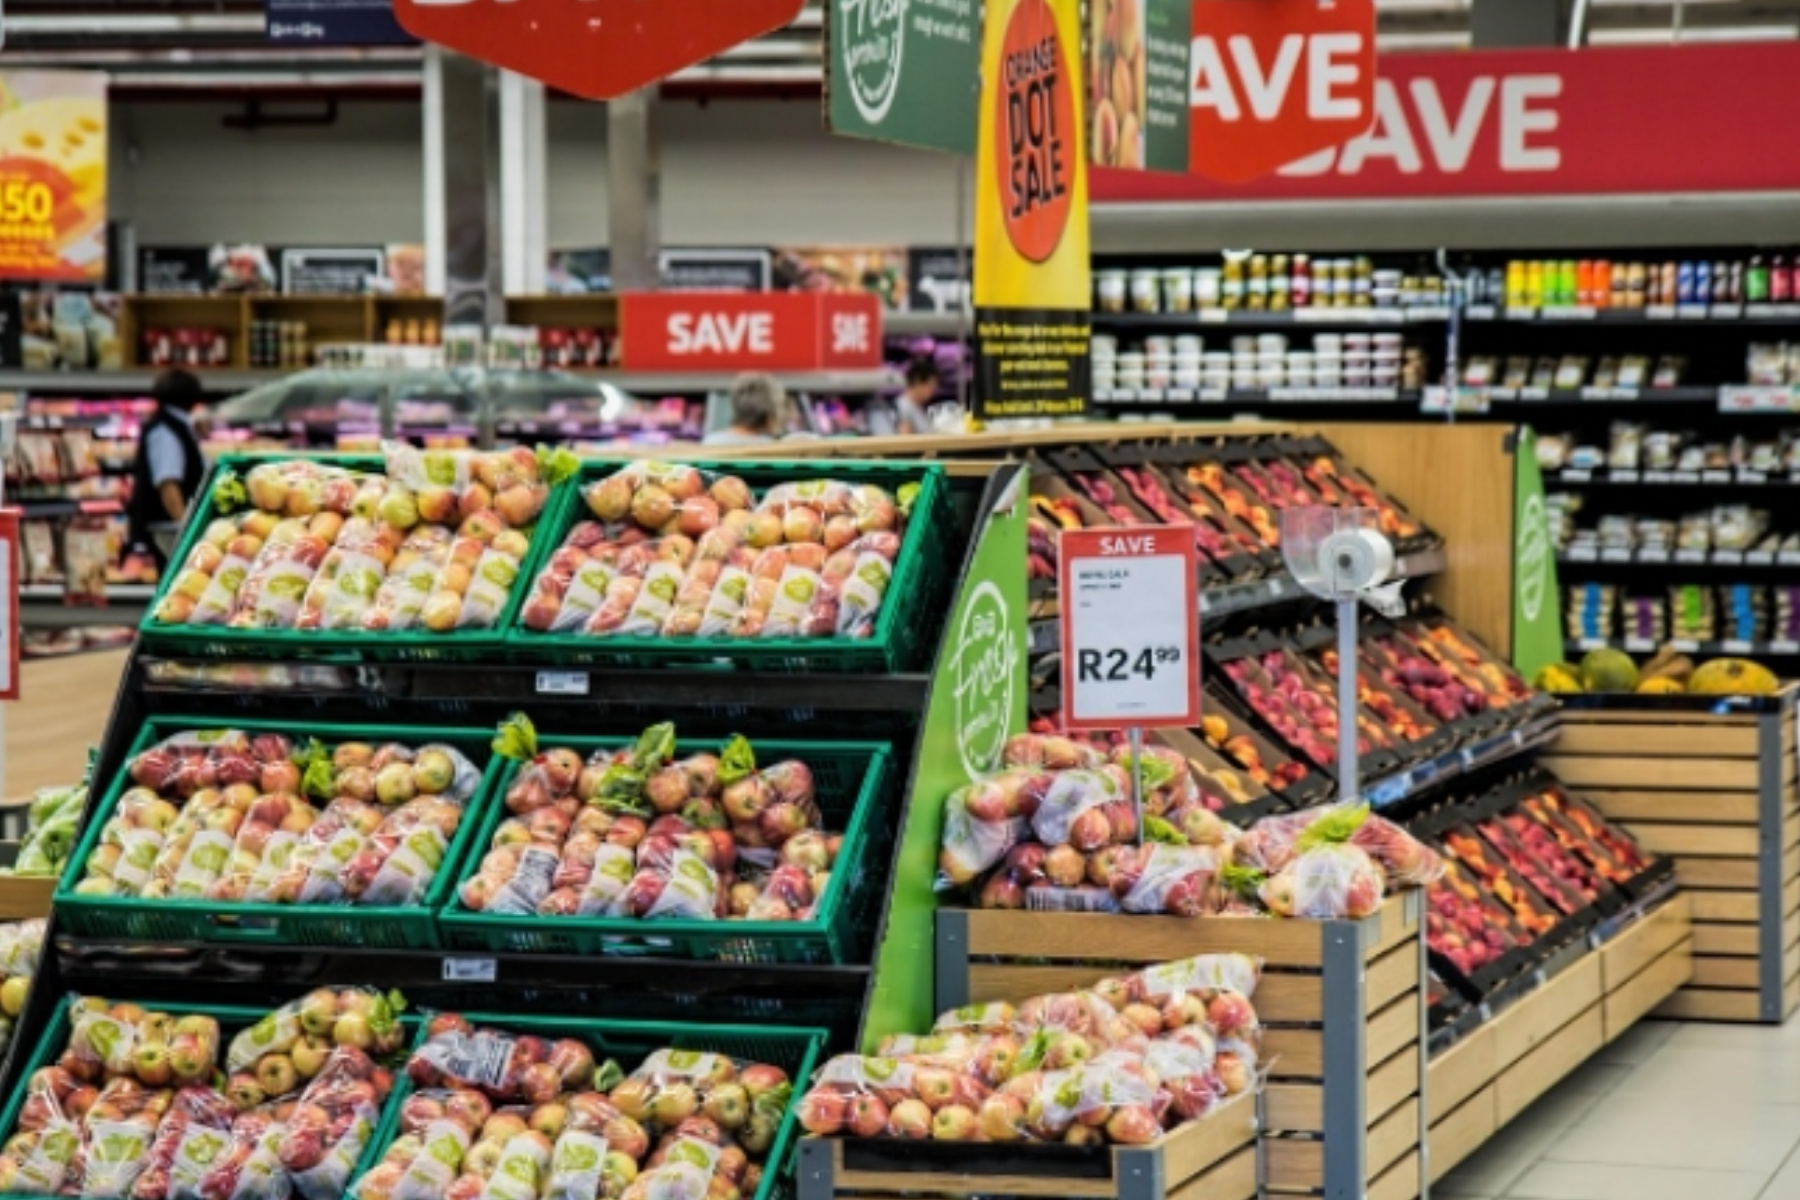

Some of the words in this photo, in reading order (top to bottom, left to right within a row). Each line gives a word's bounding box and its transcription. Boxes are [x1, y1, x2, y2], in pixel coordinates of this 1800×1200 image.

[1005, 35, 1057, 89] ORANGE
[1189, 32, 1363, 121] AVE
[1008, 74, 1056, 157] DOT
[1276, 74, 1562, 177] AVE
[0, 182, 52, 222] 50
[1011, 139, 1066, 219] SALE
[667, 312, 774, 353] SAVE
[1099, 535, 1156, 555] SAVE
